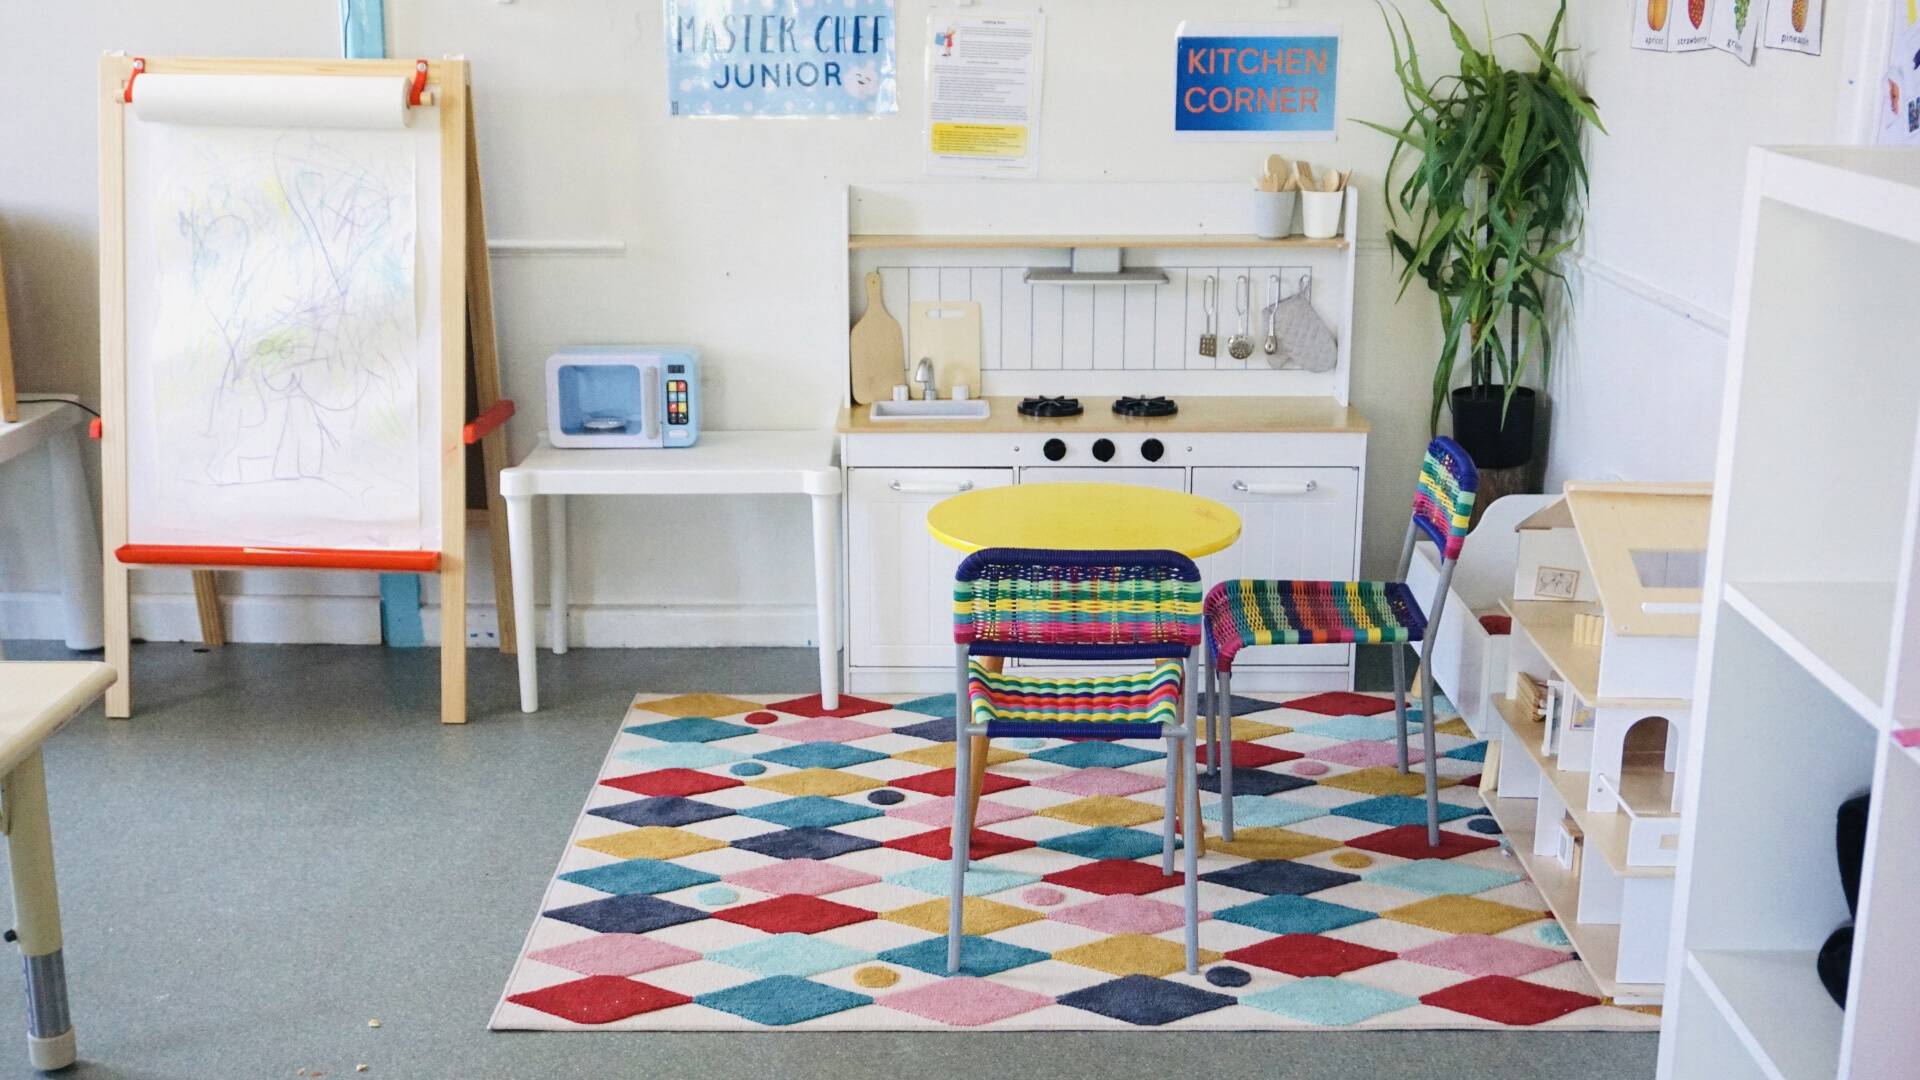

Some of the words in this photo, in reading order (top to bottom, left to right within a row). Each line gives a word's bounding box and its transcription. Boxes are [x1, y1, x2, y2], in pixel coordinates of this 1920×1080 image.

[676, 14, 799, 53] MASTER
[814, 15, 887, 53] CHEF
[713, 61, 842, 88] JUNIOR
[1187, 48, 1327, 75] KITCHEN
[1184, 86, 1319, 113] CORNER
